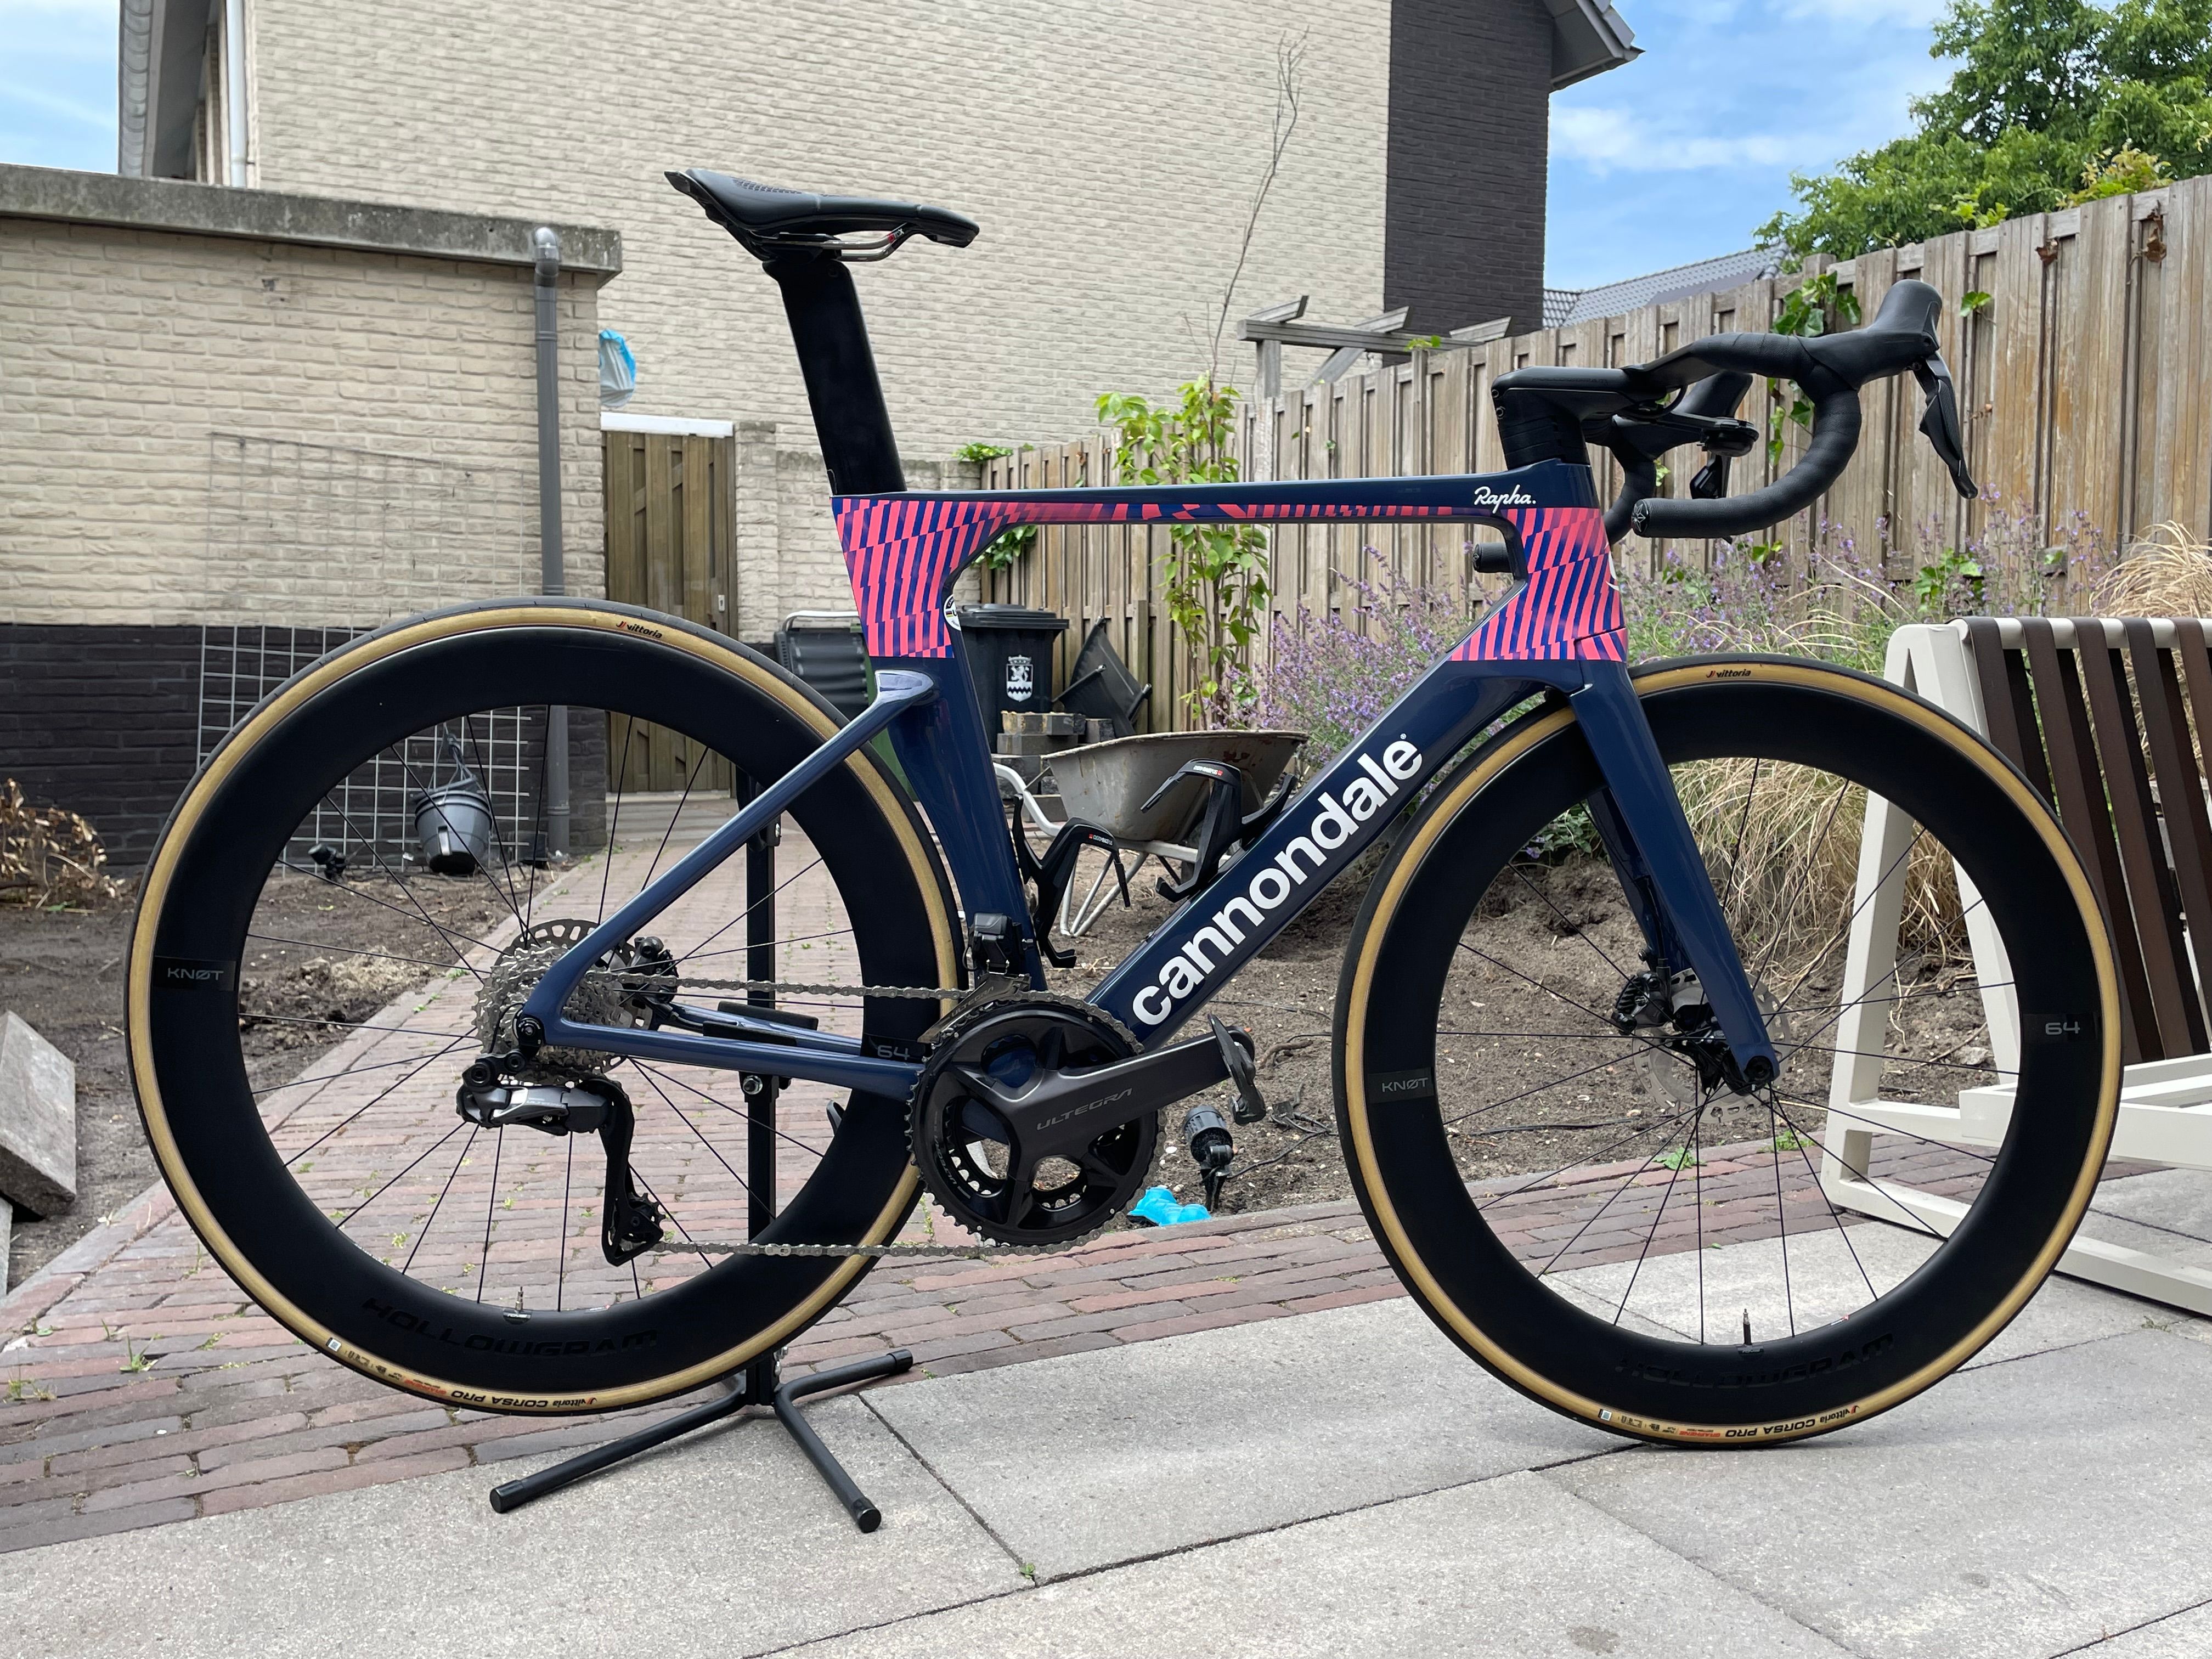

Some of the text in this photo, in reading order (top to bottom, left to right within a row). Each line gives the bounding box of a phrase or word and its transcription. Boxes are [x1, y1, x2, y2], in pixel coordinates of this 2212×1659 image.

[627, 623, 663, 639] vittoria
[1717, 669, 1751, 677] vittoria
[1132, 741, 1423, 1025] cannondale
[2045, 1021, 2080, 1035] 64
[877, 1045, 910, 1060] 64
[1036, 1088, 1132, 1131] ULTEGRA
[452, 1391, 486, 1402] PRO
[490, 1396, 548, 1408] CORSA
[552, 1400, 585, 1408] vittoria
[1820, 1408, 1850, 1423] vittoria
[1725, 1427, 1757, 1437] PRO
[1763, 1419, 1815, 1434] CORSA
